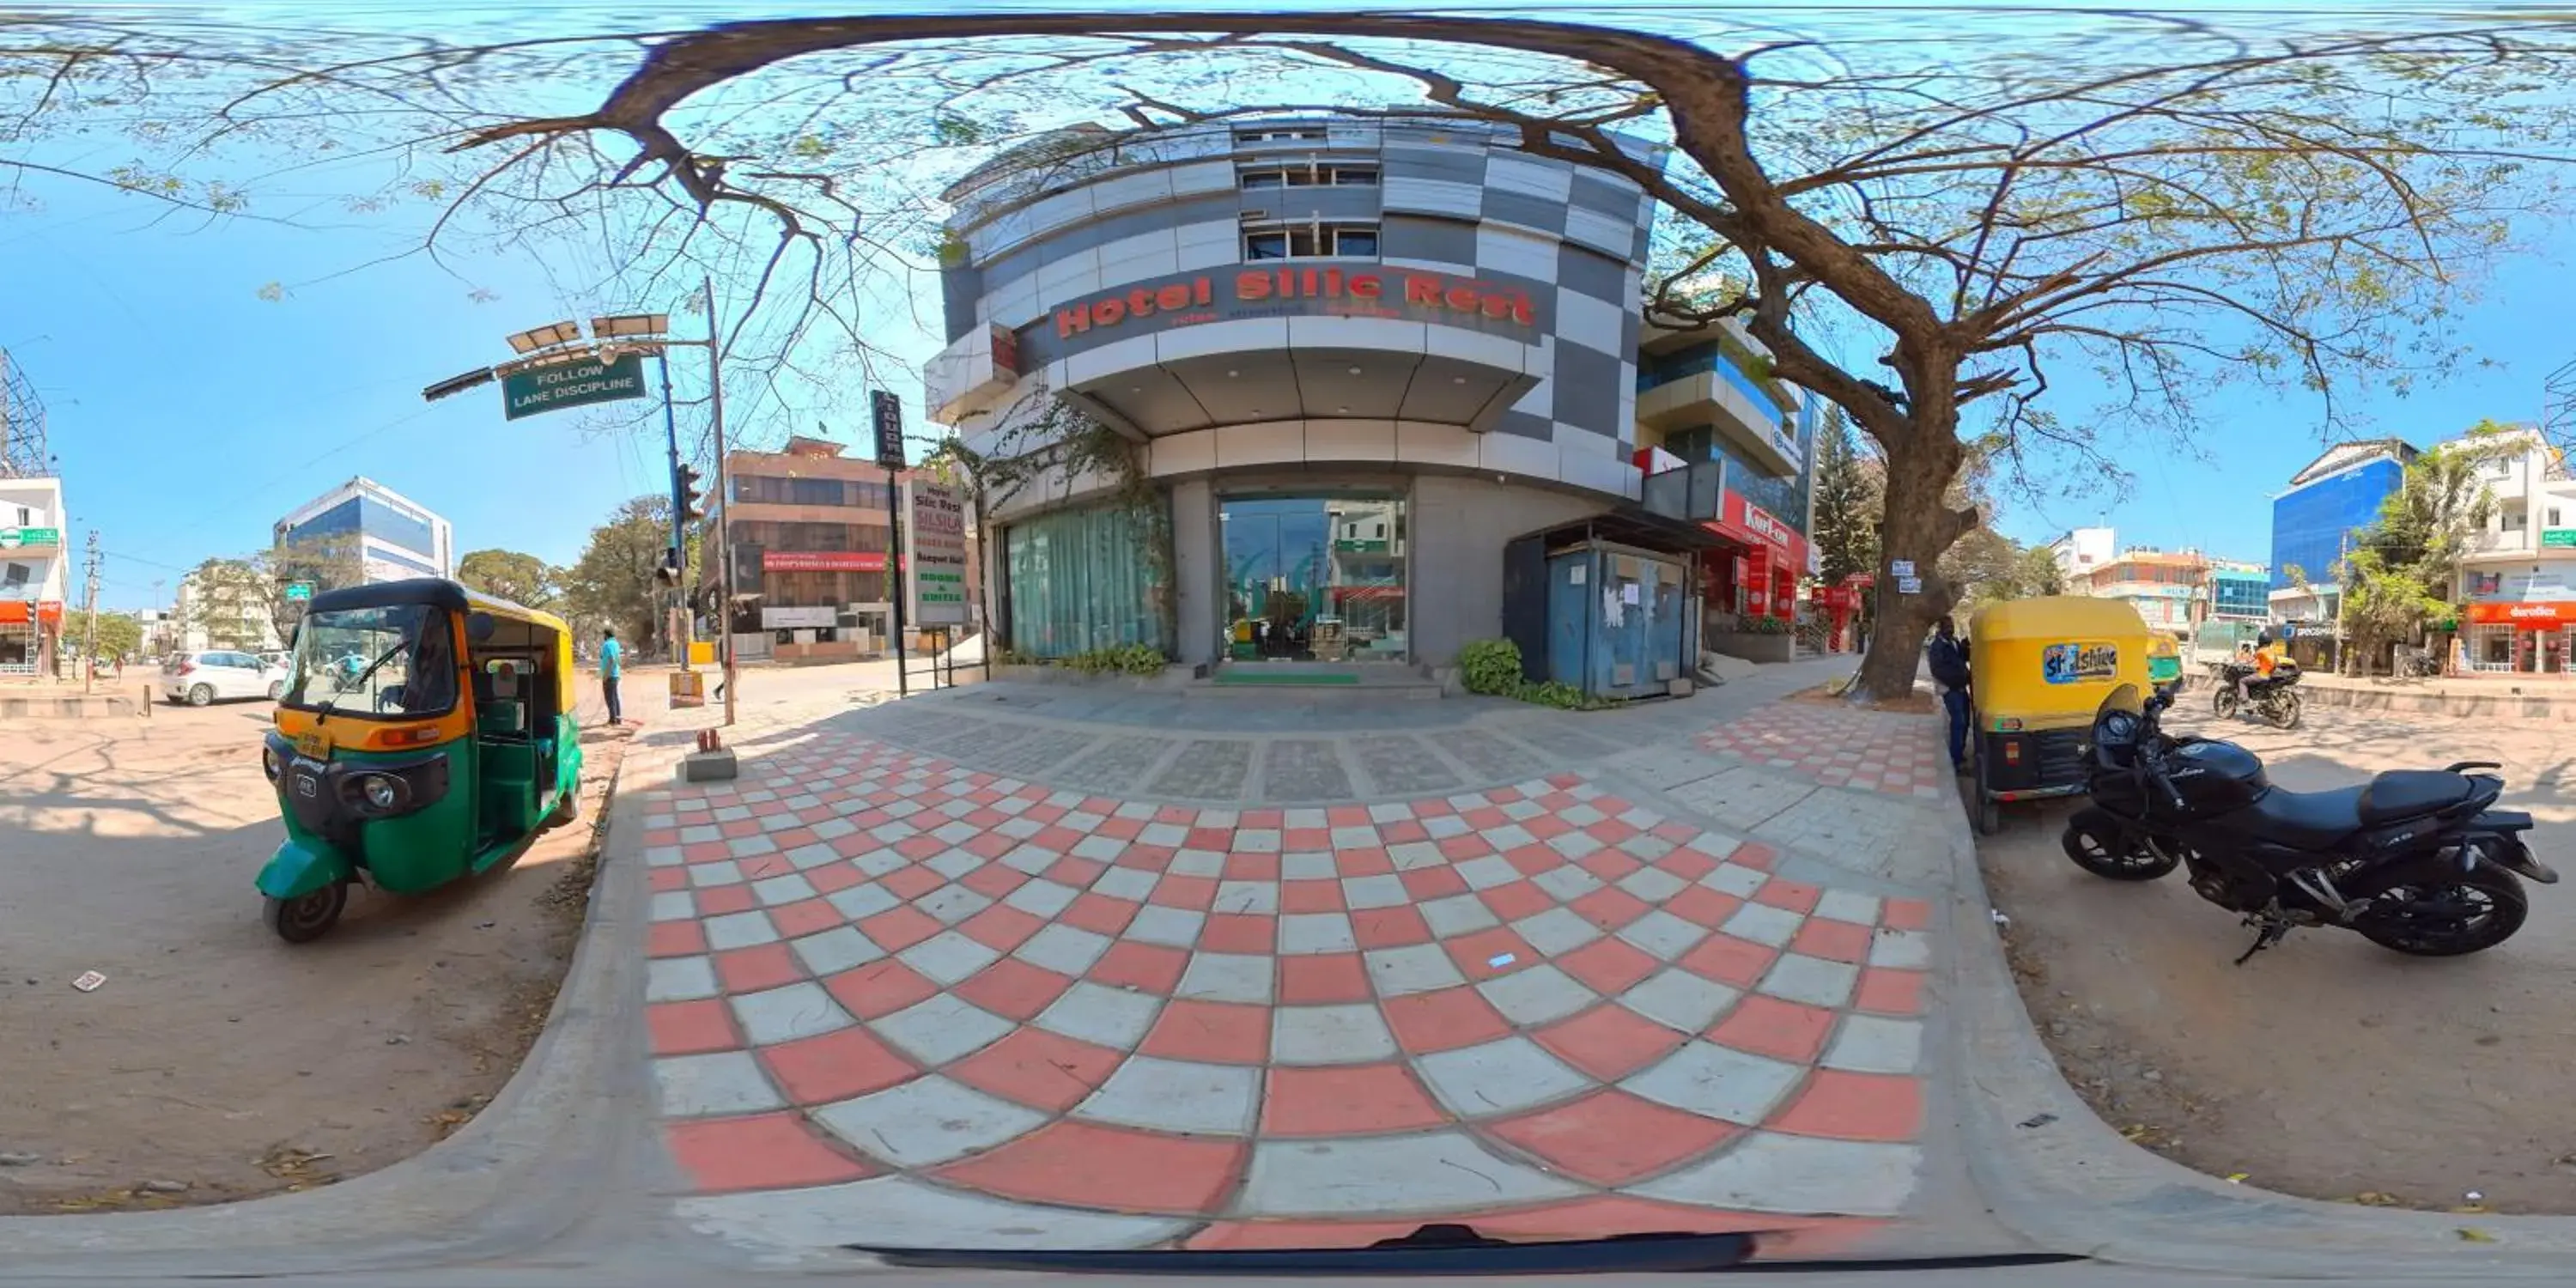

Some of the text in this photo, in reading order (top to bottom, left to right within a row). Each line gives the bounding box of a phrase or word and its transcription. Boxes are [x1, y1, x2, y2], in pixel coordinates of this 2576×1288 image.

[1056, 267, 1536, 338] Hotel Silic Rest
[537, 365, 605, 386] FOLLOW
[514, 378, 635, 408] LANE DISCIPLINE
